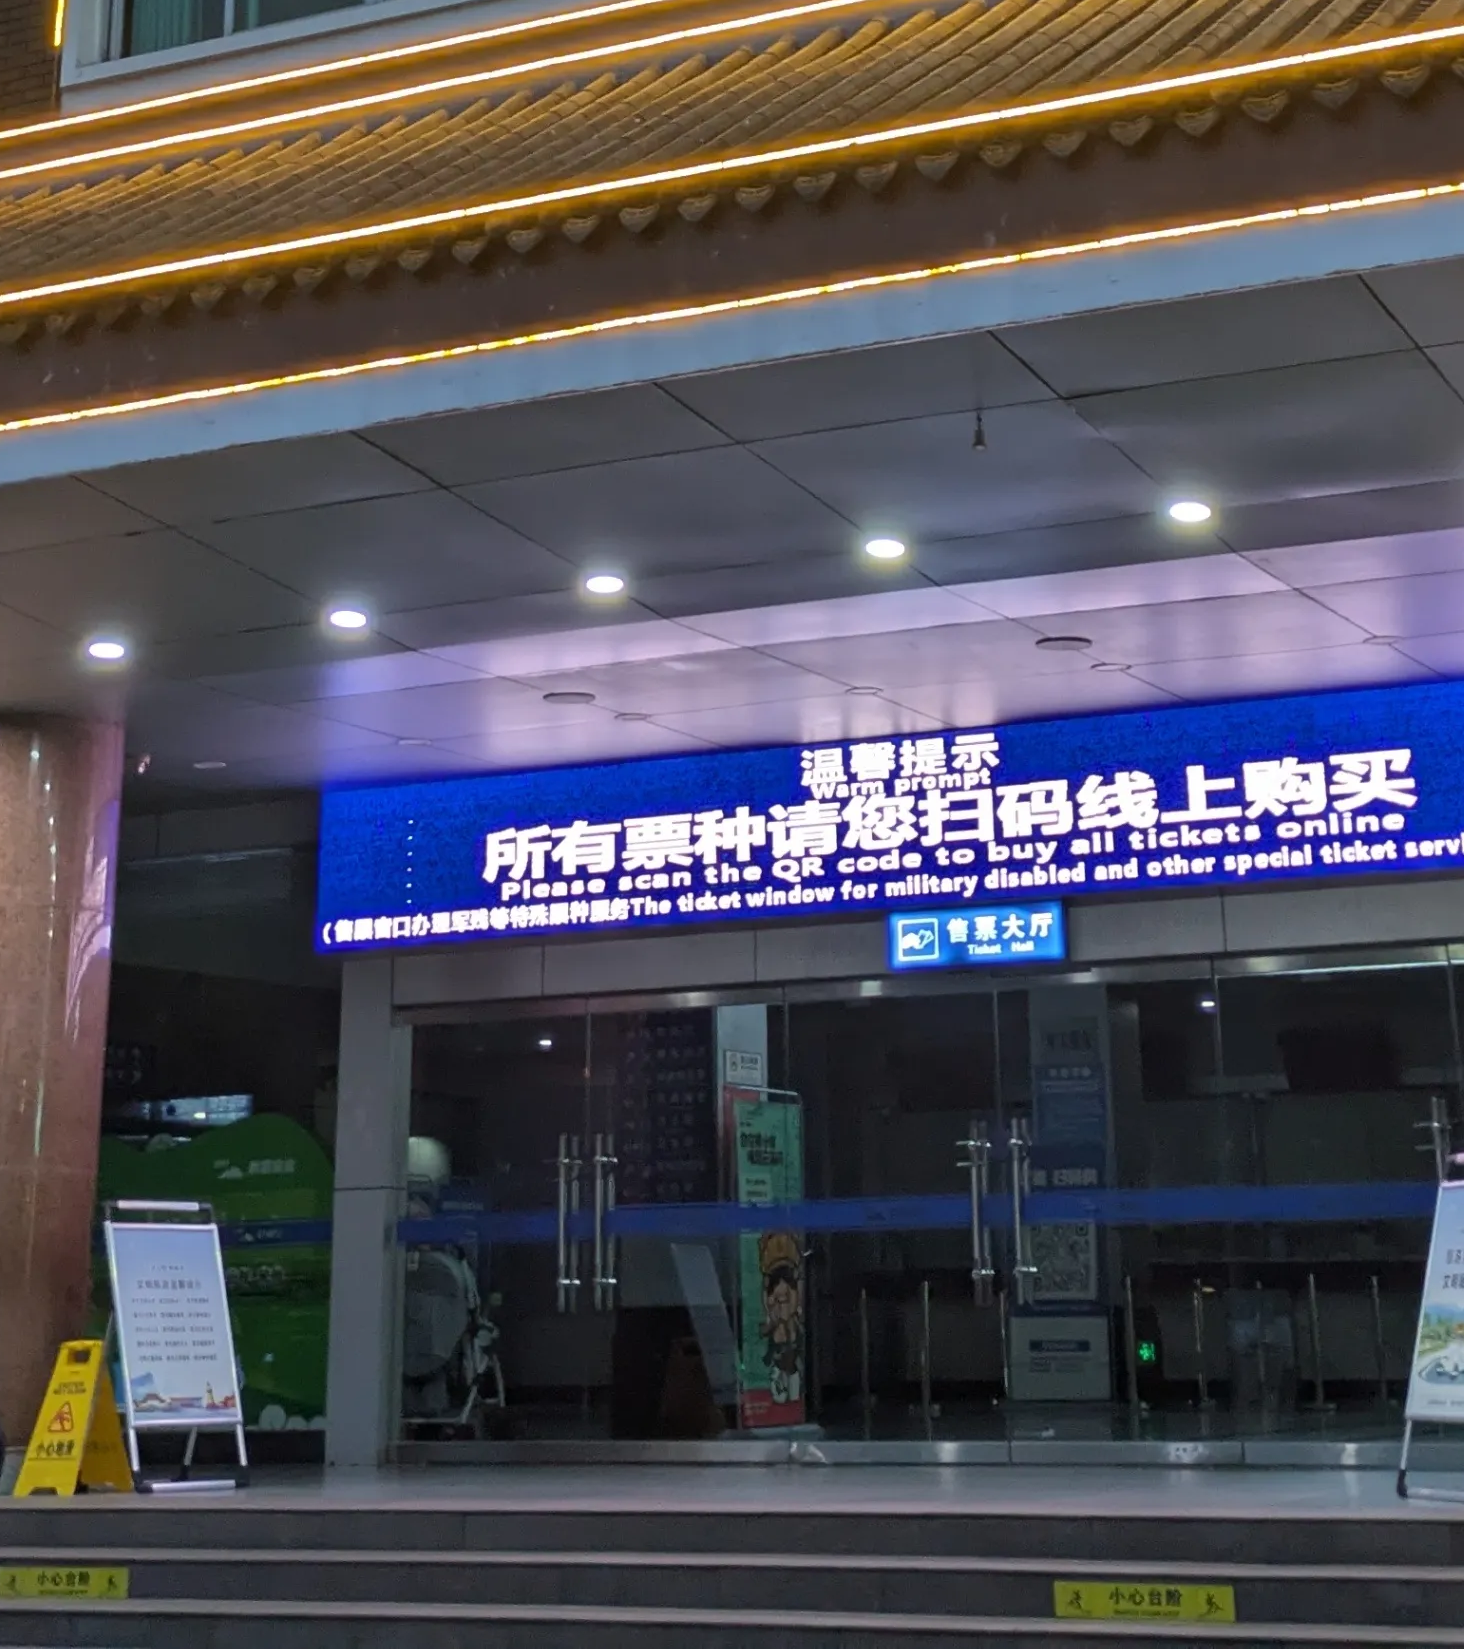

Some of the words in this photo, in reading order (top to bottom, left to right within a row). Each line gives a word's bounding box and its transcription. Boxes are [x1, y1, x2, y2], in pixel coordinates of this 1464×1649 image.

[800, 732, 1000, 787] 温馨提示
[811, 778, 885, 799] Warm
[895, 769, 991, 794] prompt
[482, 748, 1418, 884] 所有票种请您扫码线上购买
[501, 876, 605, 901] Please
[618, 870, 691, 889] scan
[704, 862, 762, 883] the
[771, 856, 826, 881] QR
[837, 848, 922, 874] code
[935, 846, 976, 867] to
[988, 839, 1058, 864] buy
[1070, 831, 1114, 855] all
[1129, 820, 1262, 849] tickets
[1276, 812, 1405, 838] online
[677, 890, 742, 912] ticket
[746, 883, 834, 907] window
[841, 879, 878, 901] for
[886, 874, 977, 898] military
[985, 862, 1085, 890] disabled
[1094, 857, 1139, 881] and
[1147, 853, 1216, 878] other
[1224, 844, 1312, 875] special
[1320, 839, 1397, 865] ticket
[947, 912, 1053, 943] 售票大厅
